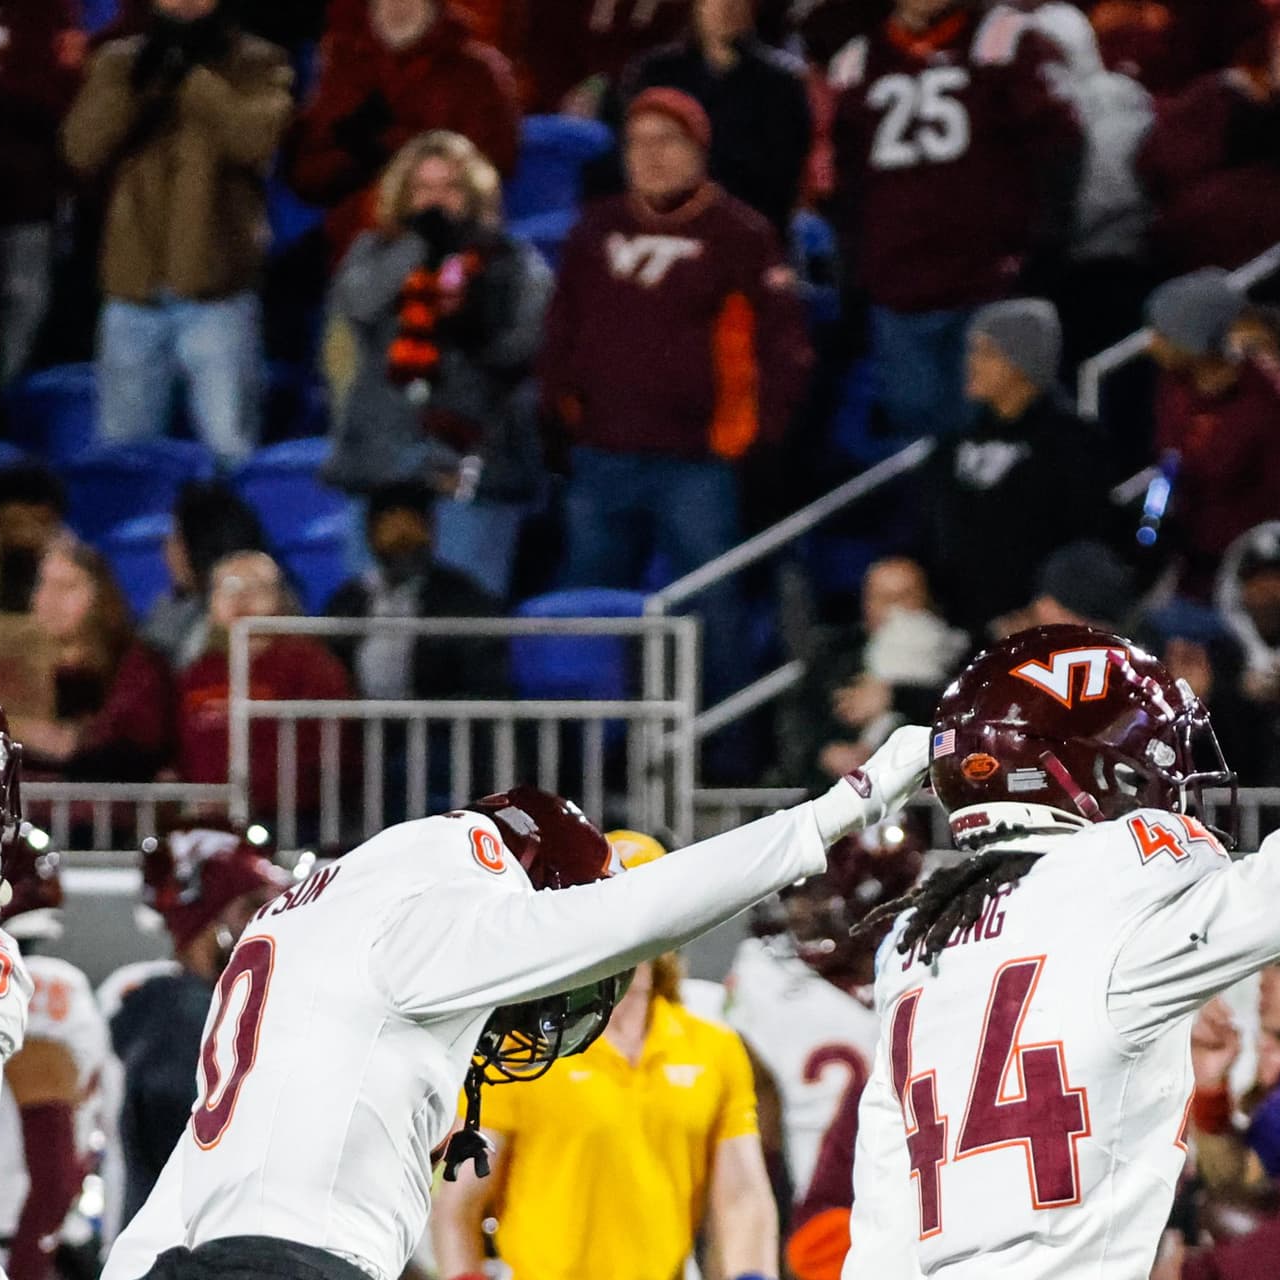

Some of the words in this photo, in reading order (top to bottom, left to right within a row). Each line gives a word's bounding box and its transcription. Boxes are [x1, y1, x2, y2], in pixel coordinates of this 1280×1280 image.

[865, 66, 972, 170] 25
[606, 232, 704, 287] VT
[1008, 646, 1131, 710] VT
[471, 826, 507, 875] 0
[192, 934, 276, 1151] 0
[888, 954, 1093, 1242] 44
